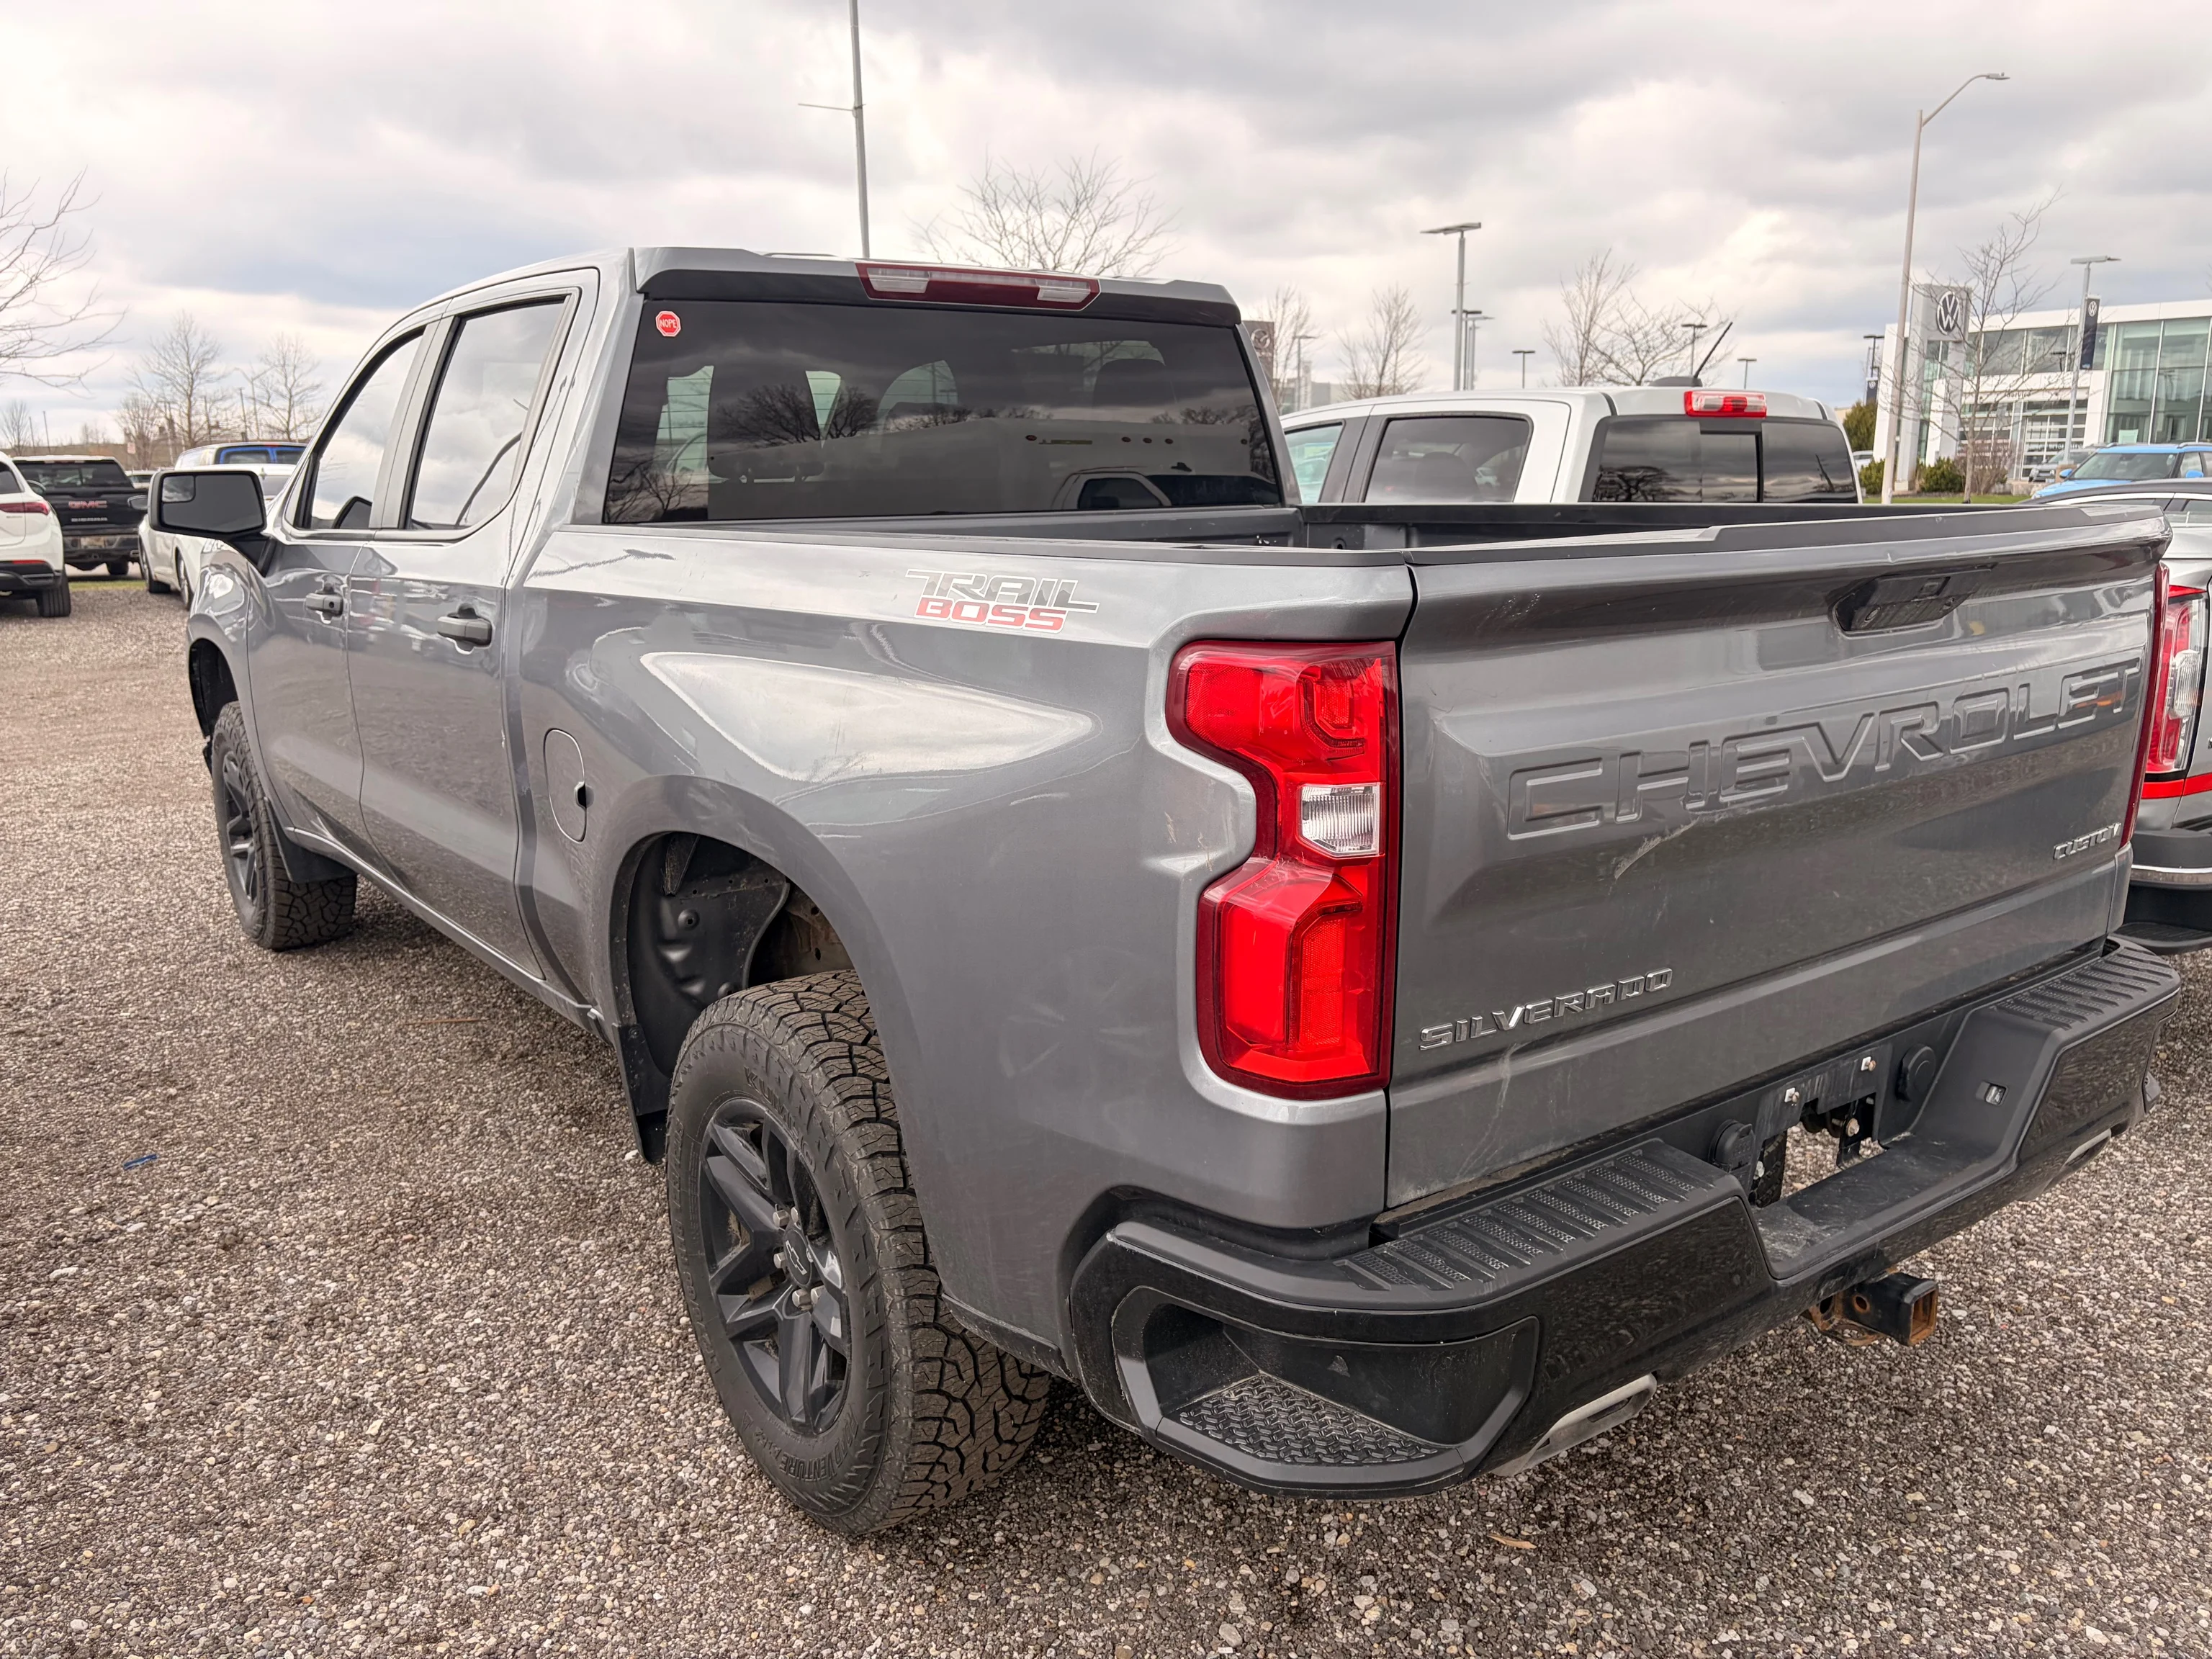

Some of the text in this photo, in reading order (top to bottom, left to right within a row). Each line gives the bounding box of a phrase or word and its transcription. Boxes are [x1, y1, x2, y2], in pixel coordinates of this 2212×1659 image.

[660, 318, 677, 329] NOPE
[68, 500, 107, 509] GMC
[905, 569, 1100, 613] TRAIL
[914, 597, 1069, 633] BOSS
[1507, 656, 2141, 840] CHEVROLET
[2053, 822, 2122, 860] CUSTOM
[1419, 967, 1674, 1051] SILVERADO
[744, 1065, 816, 1174] KUMHO
[780, 1452, 837, 1481] VENTURE
